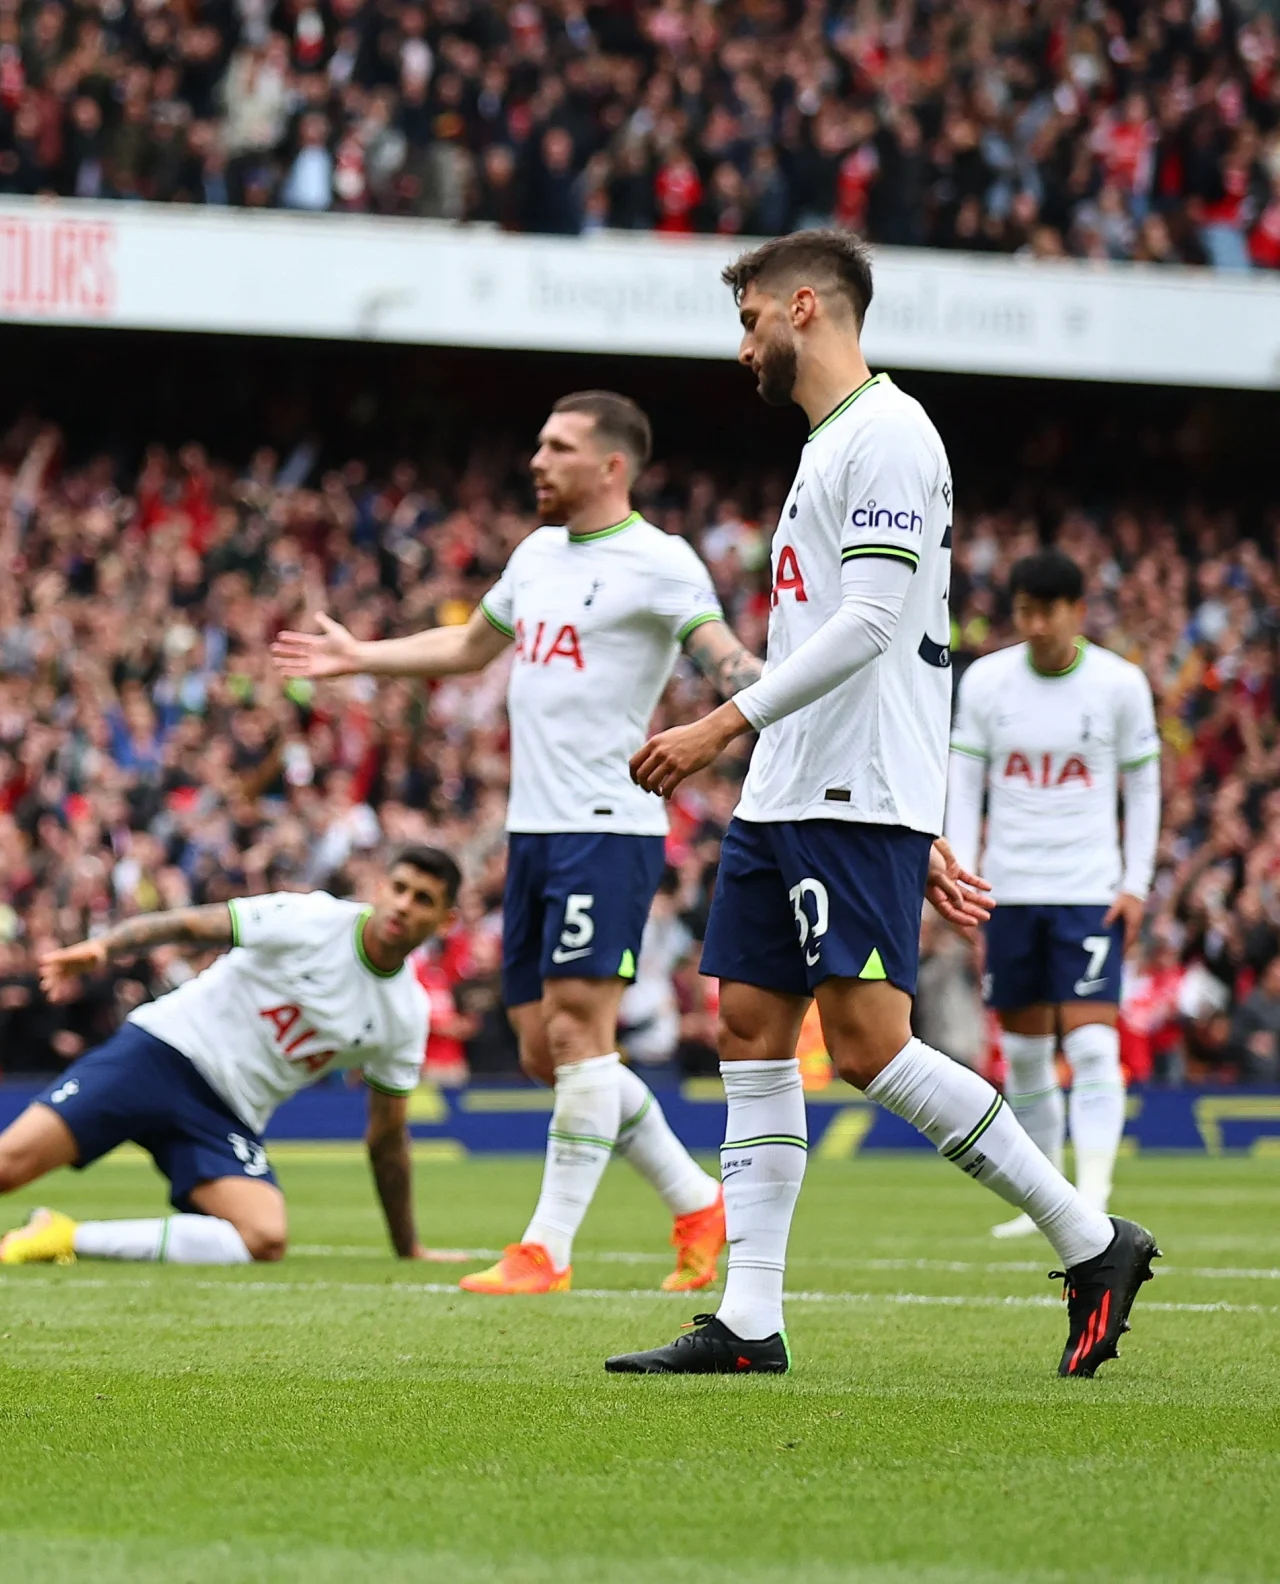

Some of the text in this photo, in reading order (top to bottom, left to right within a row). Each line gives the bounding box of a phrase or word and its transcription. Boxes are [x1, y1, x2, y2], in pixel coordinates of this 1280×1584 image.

[851, 499, 924, 535] cinch
[1003, 750, 1094, 788] AIA
[559, 894, 595, 949] 5
[788, 877, 829, 947] 30
[1082, 935, 1111, 981] 7
[258, 1003, 337, 1073] AIA
